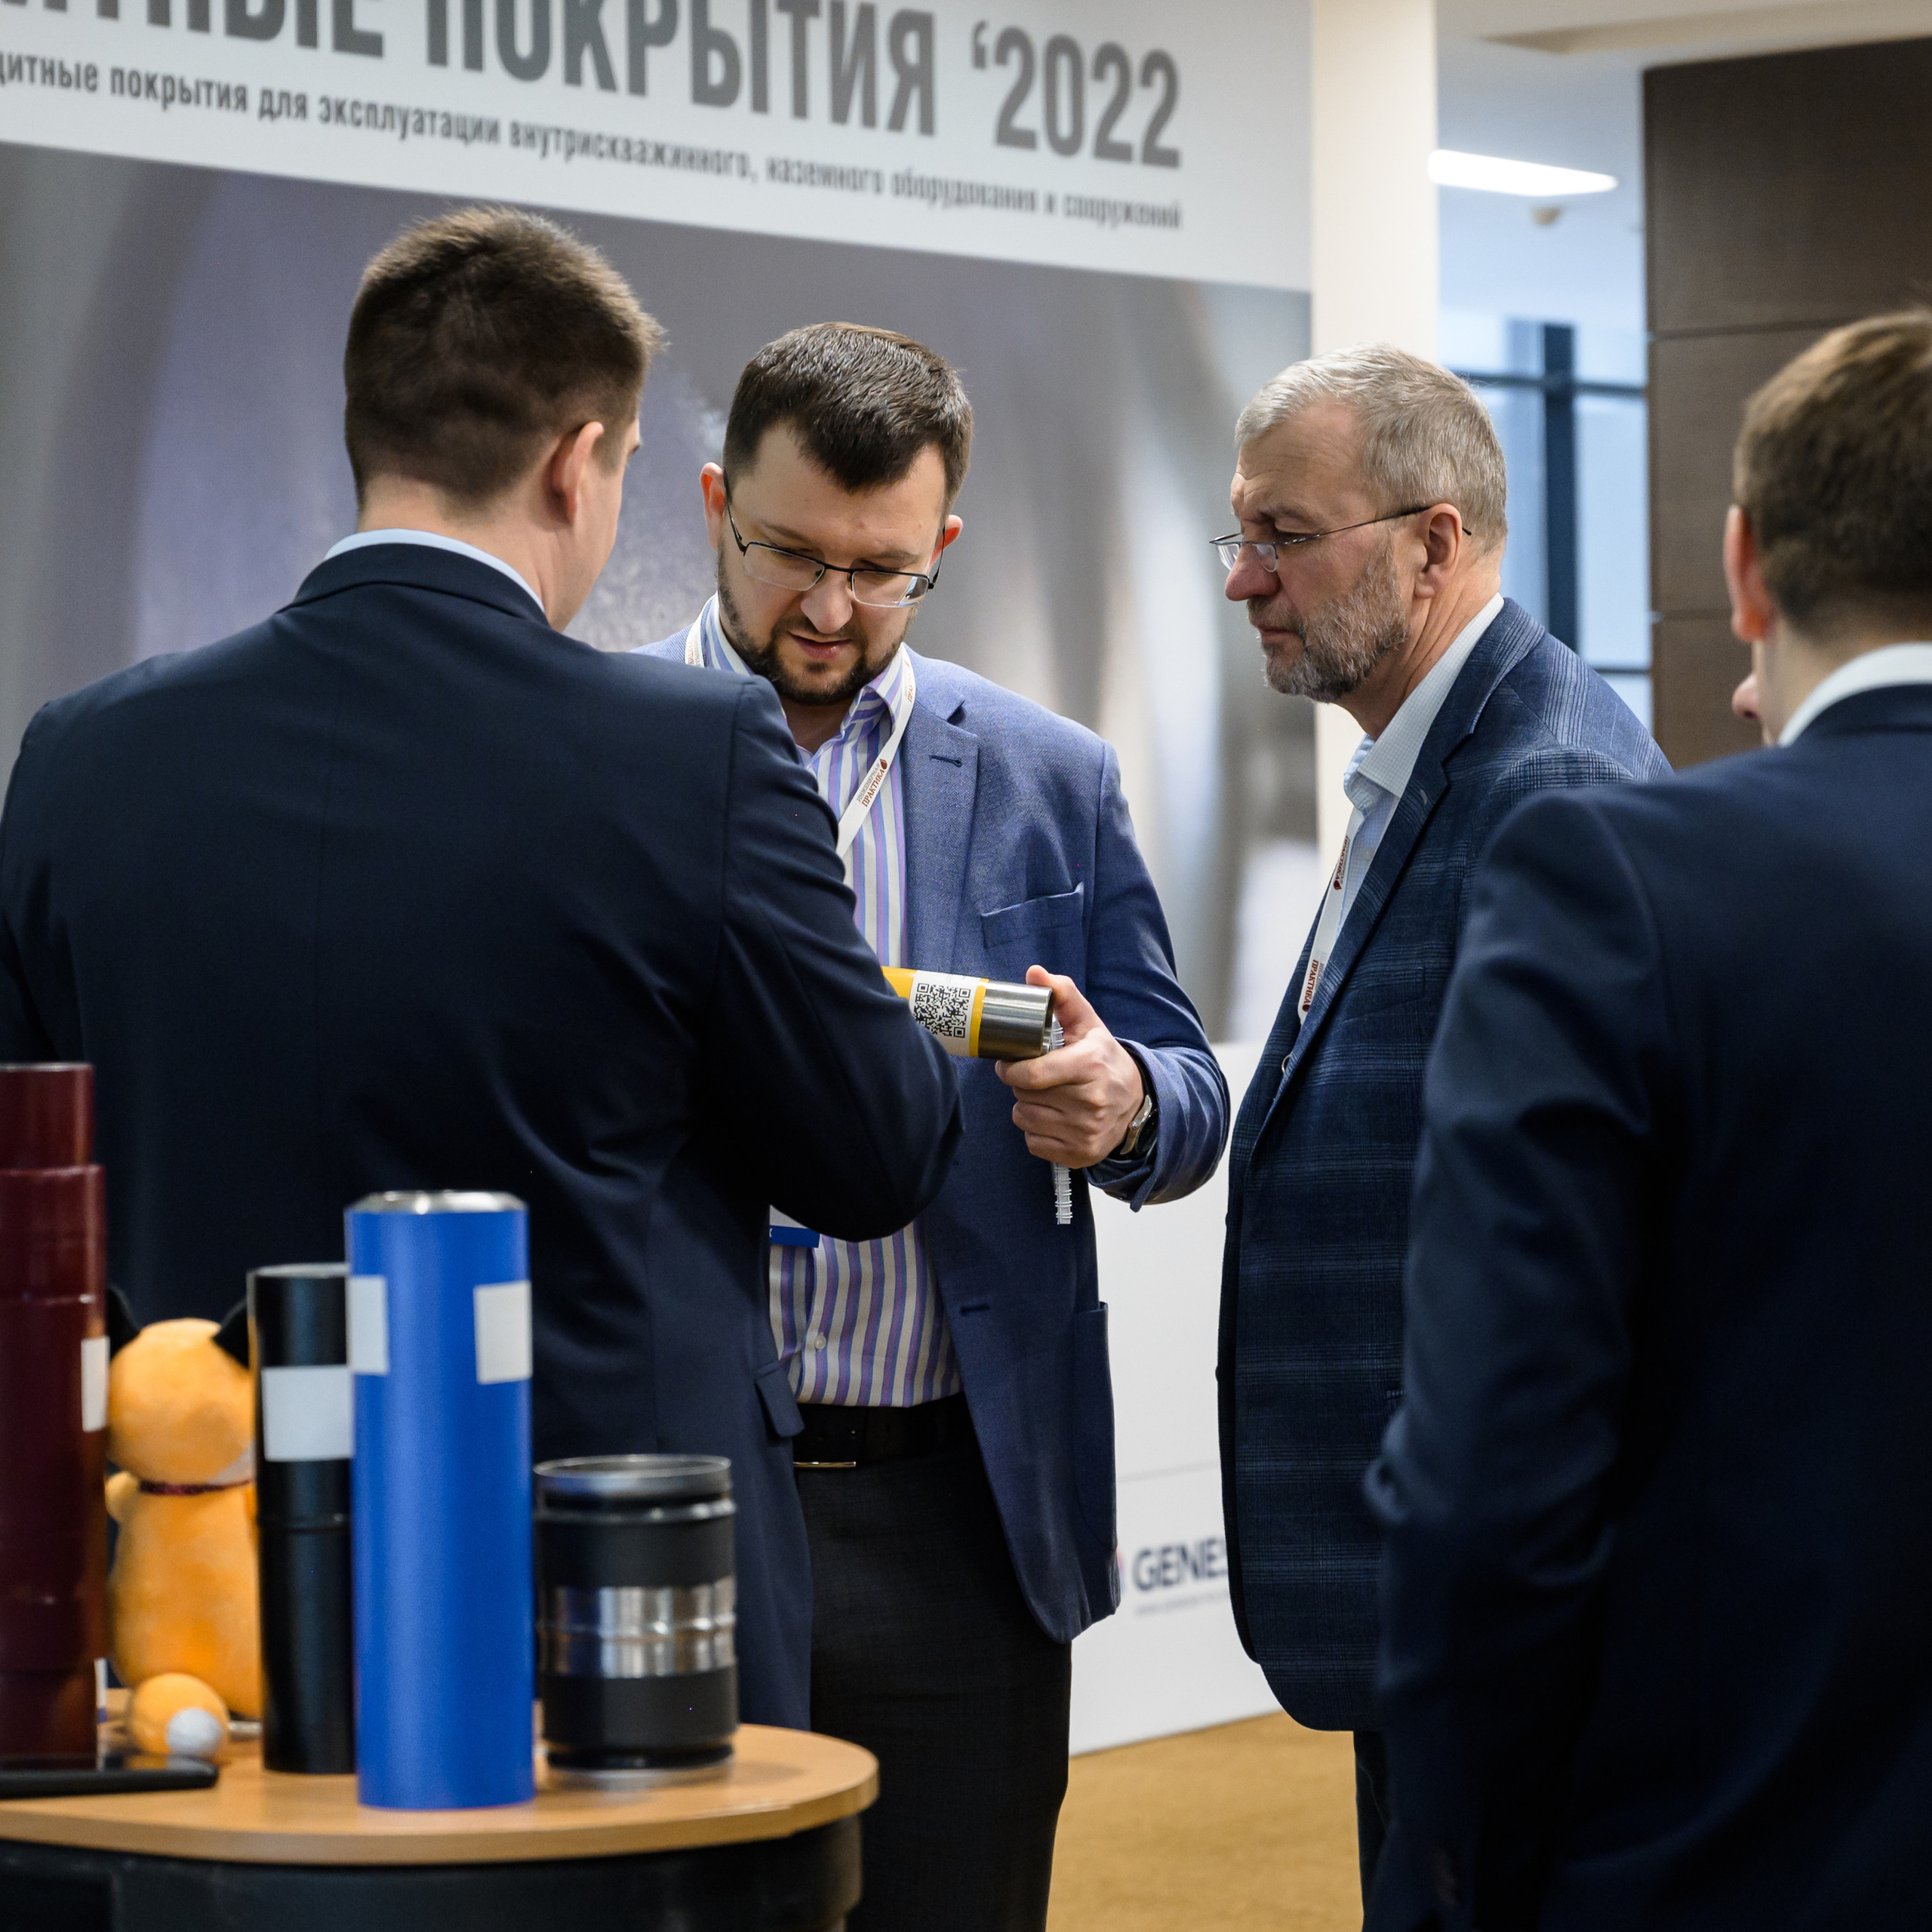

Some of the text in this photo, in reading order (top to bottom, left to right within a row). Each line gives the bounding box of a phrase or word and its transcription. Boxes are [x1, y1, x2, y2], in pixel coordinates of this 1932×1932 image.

[0, 51, 98, 92] итные
[110, 66, 248, 112] покрытия
[259, 88, 308, 122] для
[318, 95, 500, 146] эксплуатации
[891, 164, 1035, 214] оборудования
[1063, 193, 1181, 229] сооружений
[861, 769, 884, 808] ПРАКТИКА
[1303, 959, 1319, 1004] ПРАКТИКА
